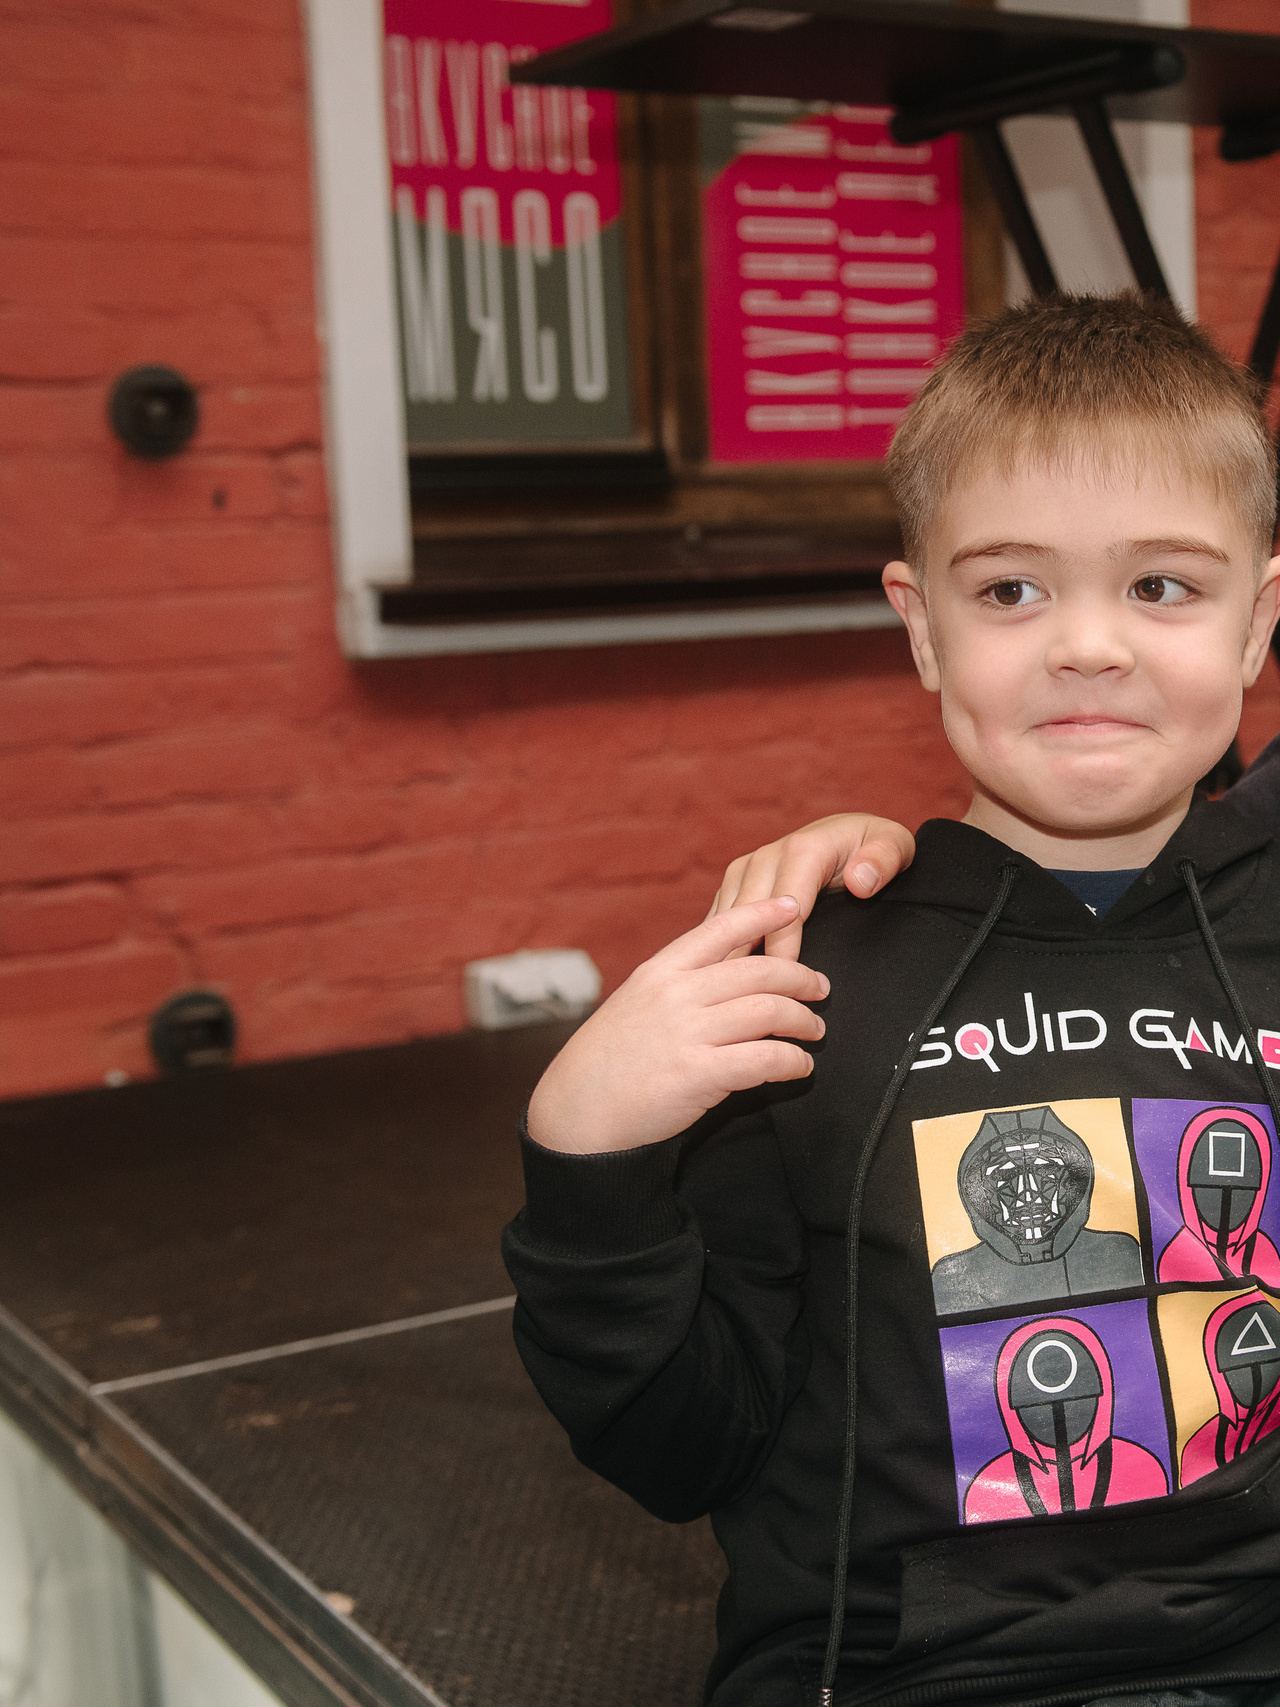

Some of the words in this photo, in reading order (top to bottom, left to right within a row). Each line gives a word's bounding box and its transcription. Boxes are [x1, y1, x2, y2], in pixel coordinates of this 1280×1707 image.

[392, 184, 609, 402] МЯСО
[734, 181, 845, 432] ВКУСНОЕ
[897, 991, 1108, 1073] SQUID
